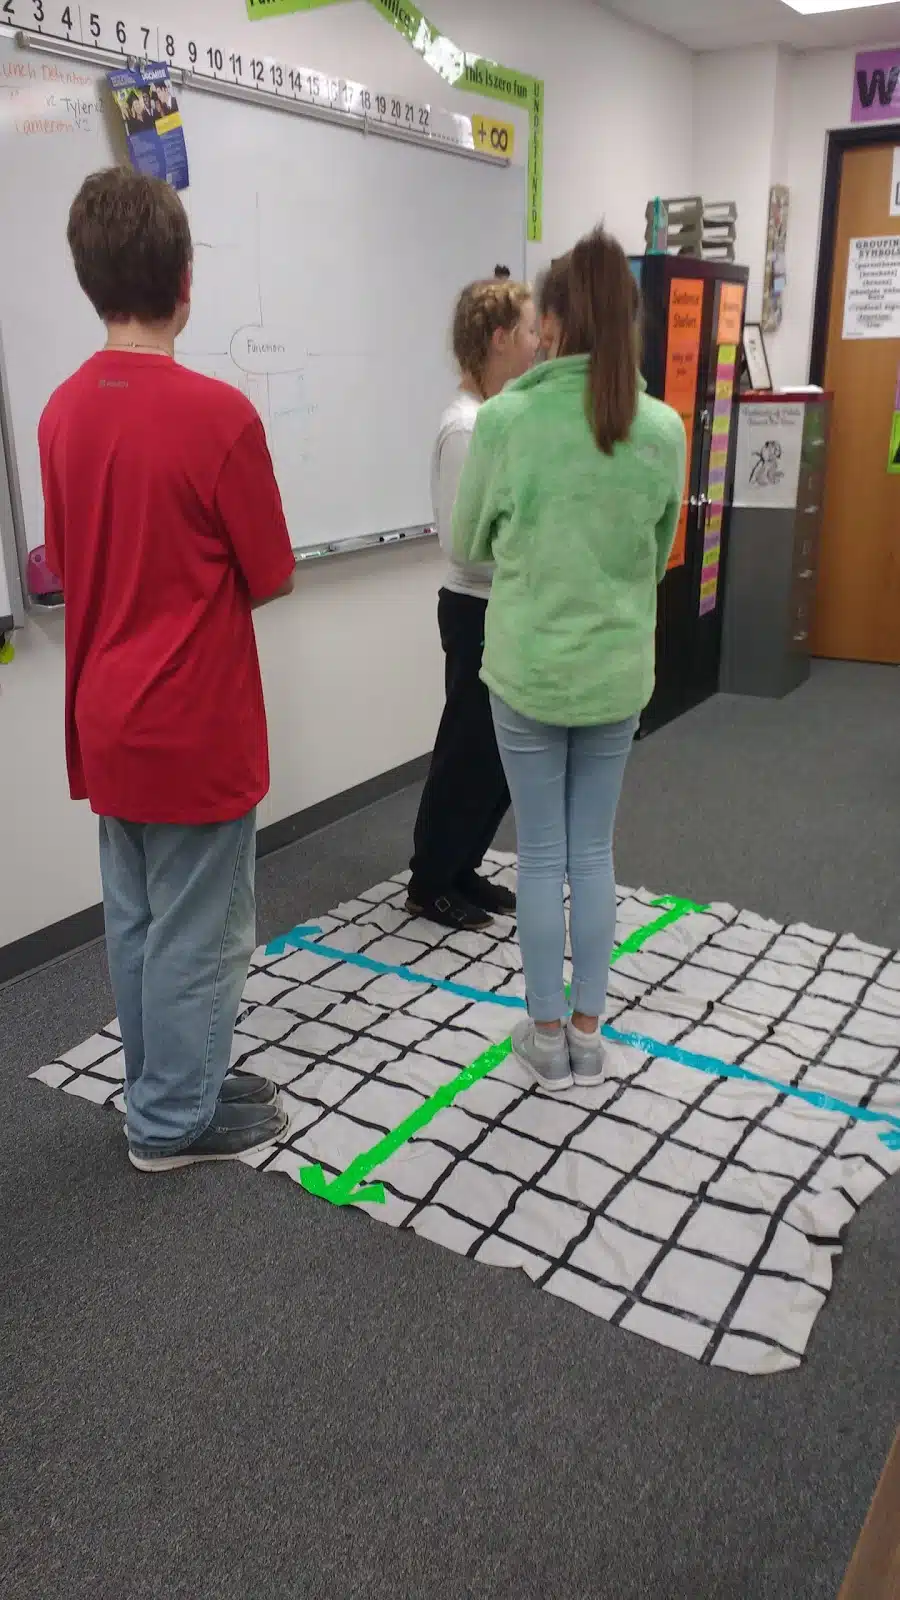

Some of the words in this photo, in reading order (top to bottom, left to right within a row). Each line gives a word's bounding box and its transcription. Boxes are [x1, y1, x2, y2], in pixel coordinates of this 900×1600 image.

[33, 0, 44, 21] 3
[61, 6, 73, 30] 4
[90, 13, 101, 37] 5
[116, 21, 127, 44] 6
[140, 27, 151, 49] 7
[165, 35, 175, 57] 8
[188, 42, 198, 63] 9
[207, 47, 223, 70] 10
[229, 53, 242, 76] 11
[250, 59, 265, 82] 12
[269, 65, 284, 87] 13
[288, 71, 303, 92] 14
[307, 77, 320, 96] 15
[325, 84, 338, 101] 16
[343, 86, 355, 106] 17
[359, 90, 371, 110] 18
[375, 95, 386, 115] 19
[391, 99, 401, 119] 20
[405, 103, 415, 123] 21
[418, 108, 429, 126] 22
[465, 65, 483, 85] This
[493, 76, 512, 95] zero
[513, 80, 528, 99] fun
[856, 67, 900, 108] W
[60, 96, 94, 118] Tyler
[246, 339, 286, 354] Function
